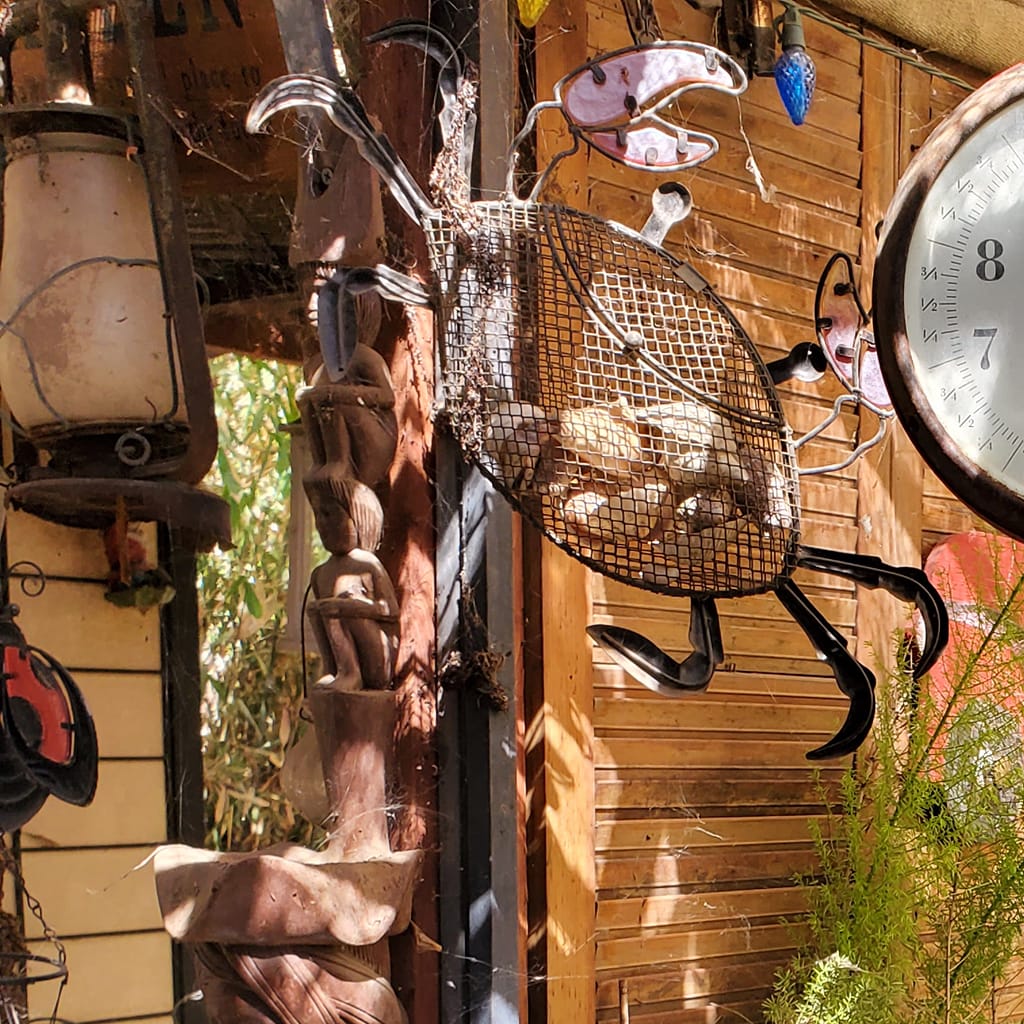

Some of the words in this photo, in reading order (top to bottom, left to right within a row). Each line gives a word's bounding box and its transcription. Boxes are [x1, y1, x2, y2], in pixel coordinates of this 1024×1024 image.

[975, 238, 1005, 282] 8
[921, 297, 938, 312] 1/2
[973, 328, 998, 370] 7
